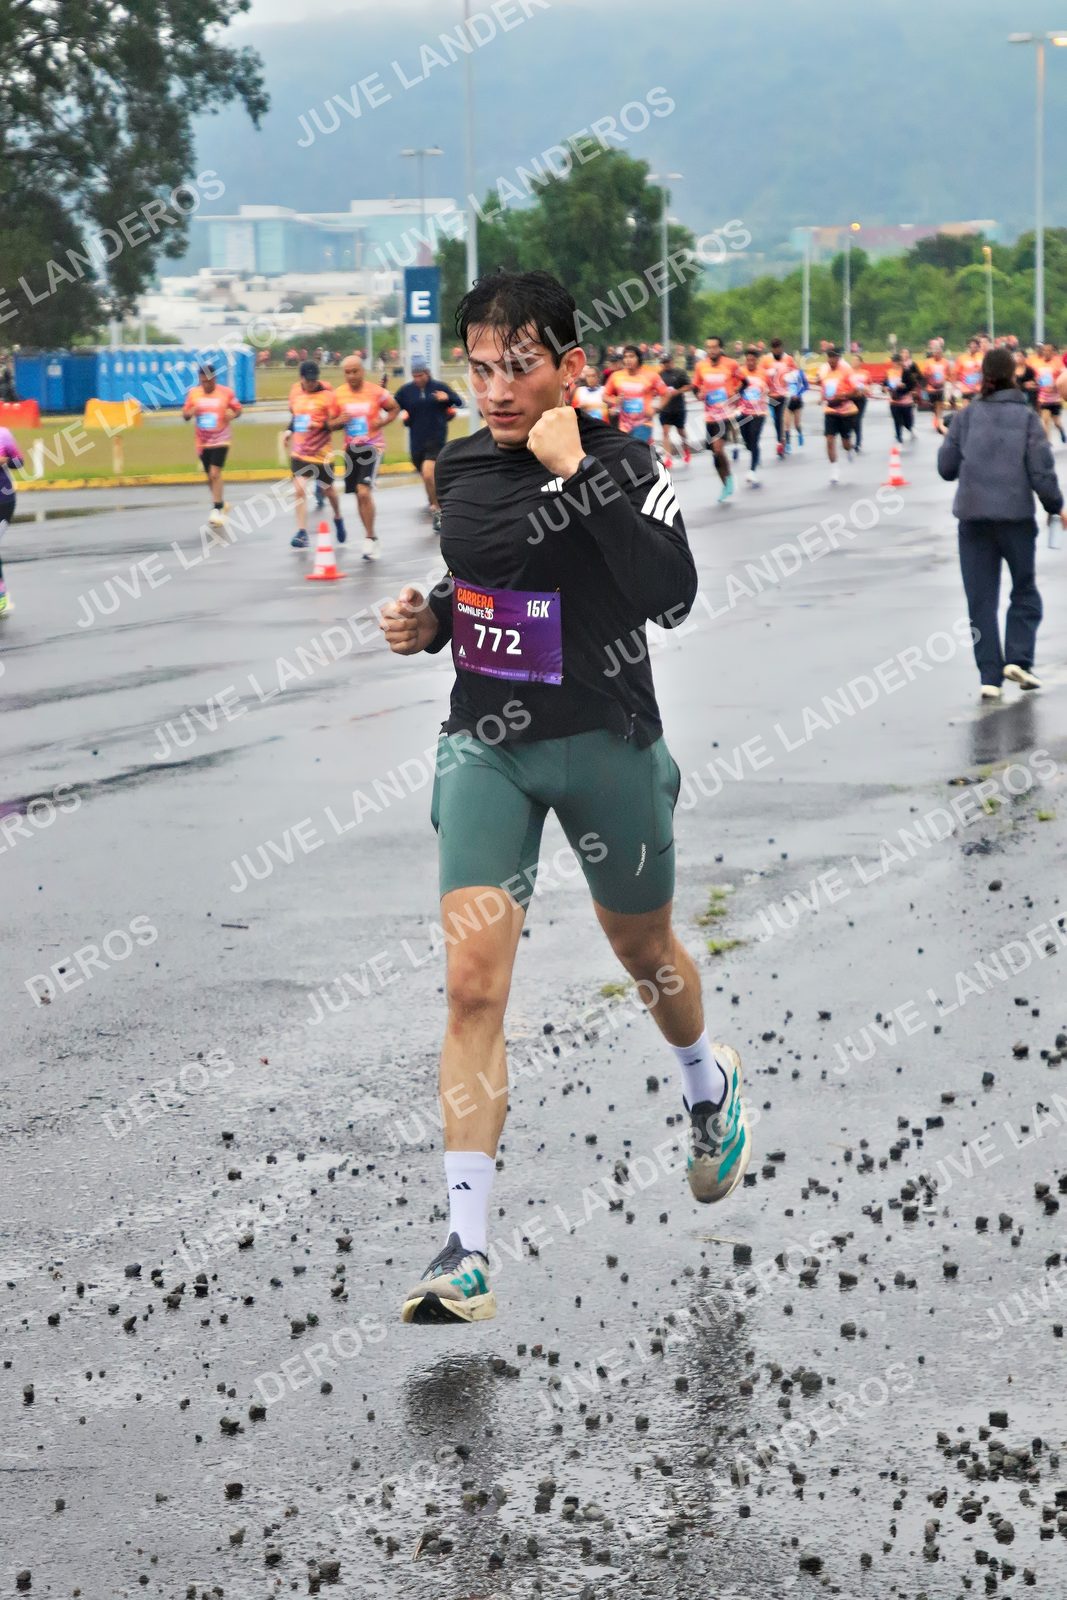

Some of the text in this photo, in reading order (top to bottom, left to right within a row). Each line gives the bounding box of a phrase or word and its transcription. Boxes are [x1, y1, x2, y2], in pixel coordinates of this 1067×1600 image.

[411, 290, 431, 317] E
[457, 588, 494, 609] CARRERA
[527, 600, 550, 618] 15K
[474, 623, 522, 655] 772
